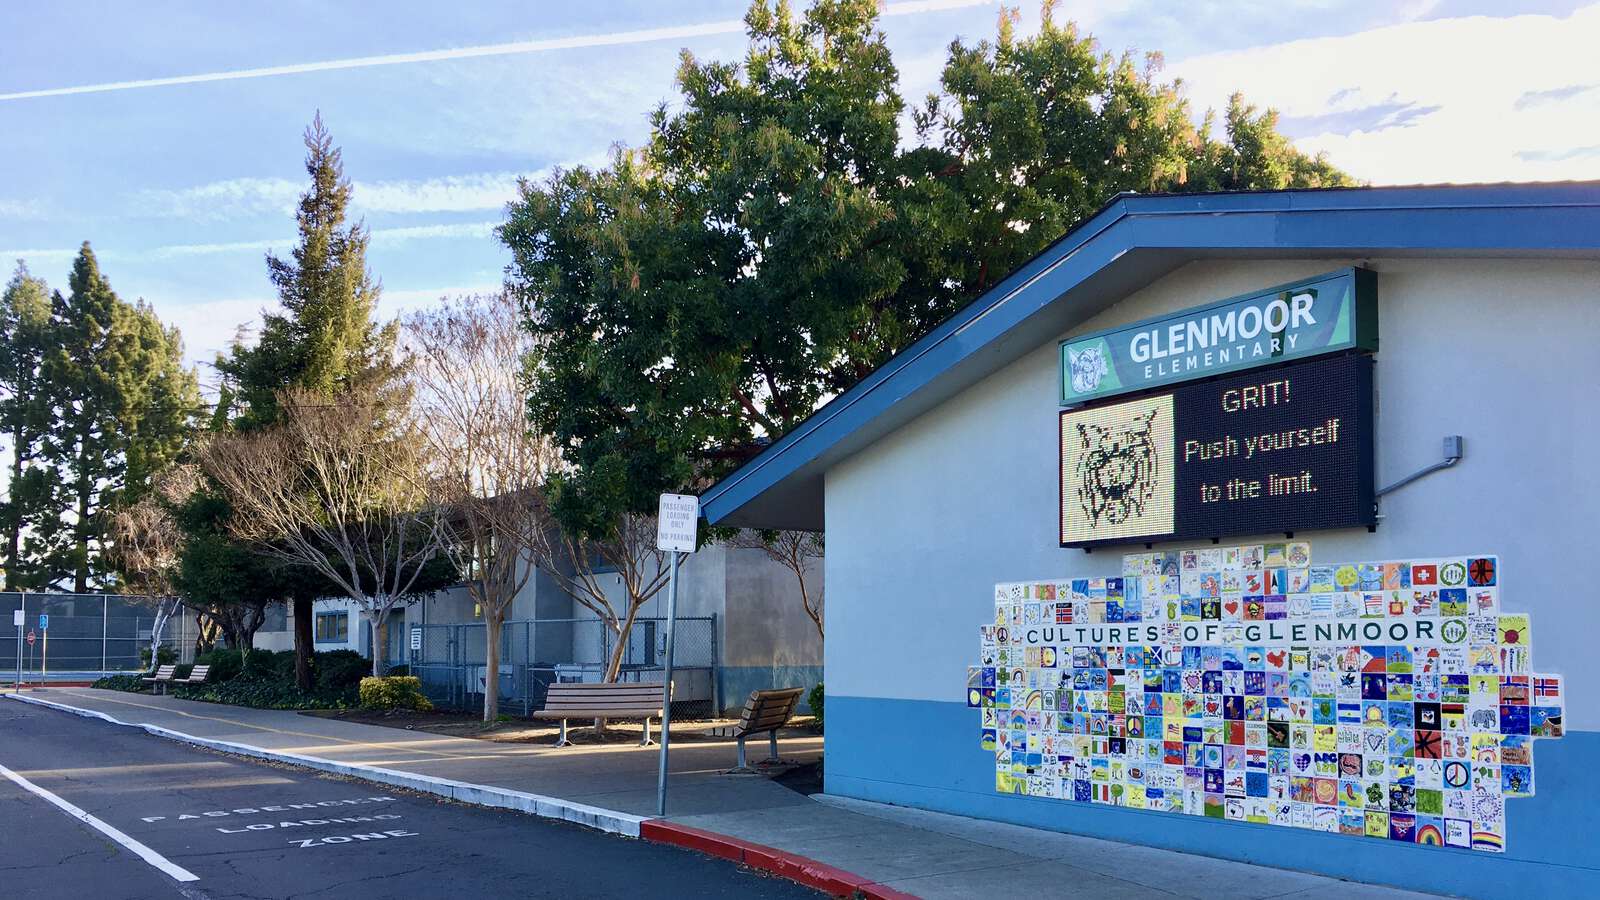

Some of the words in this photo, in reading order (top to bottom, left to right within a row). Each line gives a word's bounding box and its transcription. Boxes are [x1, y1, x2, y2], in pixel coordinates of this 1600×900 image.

[1129, 293, 1317, 363] GLENMOOR
[1144, 333, 1299, 379] ELEMENTARY
[1221, 379, 1291, 413] GRIT!
[1183, 434, 1238, 463] Push
[1243, 418, 1341, 459] yourself
[1200, 482, 1219, 503] to
[1226, 477, 1260, 500] the
[1267, 470, 1319, 496] limit.
[663, 502, 694, 512] PASSENGER
[666, 511, 690, 520] LOADING
[670, 520, 685, 528] ONLY
[660, 532, 669, 540] NO
[670, 533, 694, 542] PARKING
[1026, 624, 1159, 643] CULTURES
[1183, 624, 1218, 642] OF
[1245, 620, 1434, 642] GLENMOOR
[141, 796, 397, 823] PASSENGER
[216, 814, 402, 834] LOADING
[288, 829, 420, 848] ZONE
